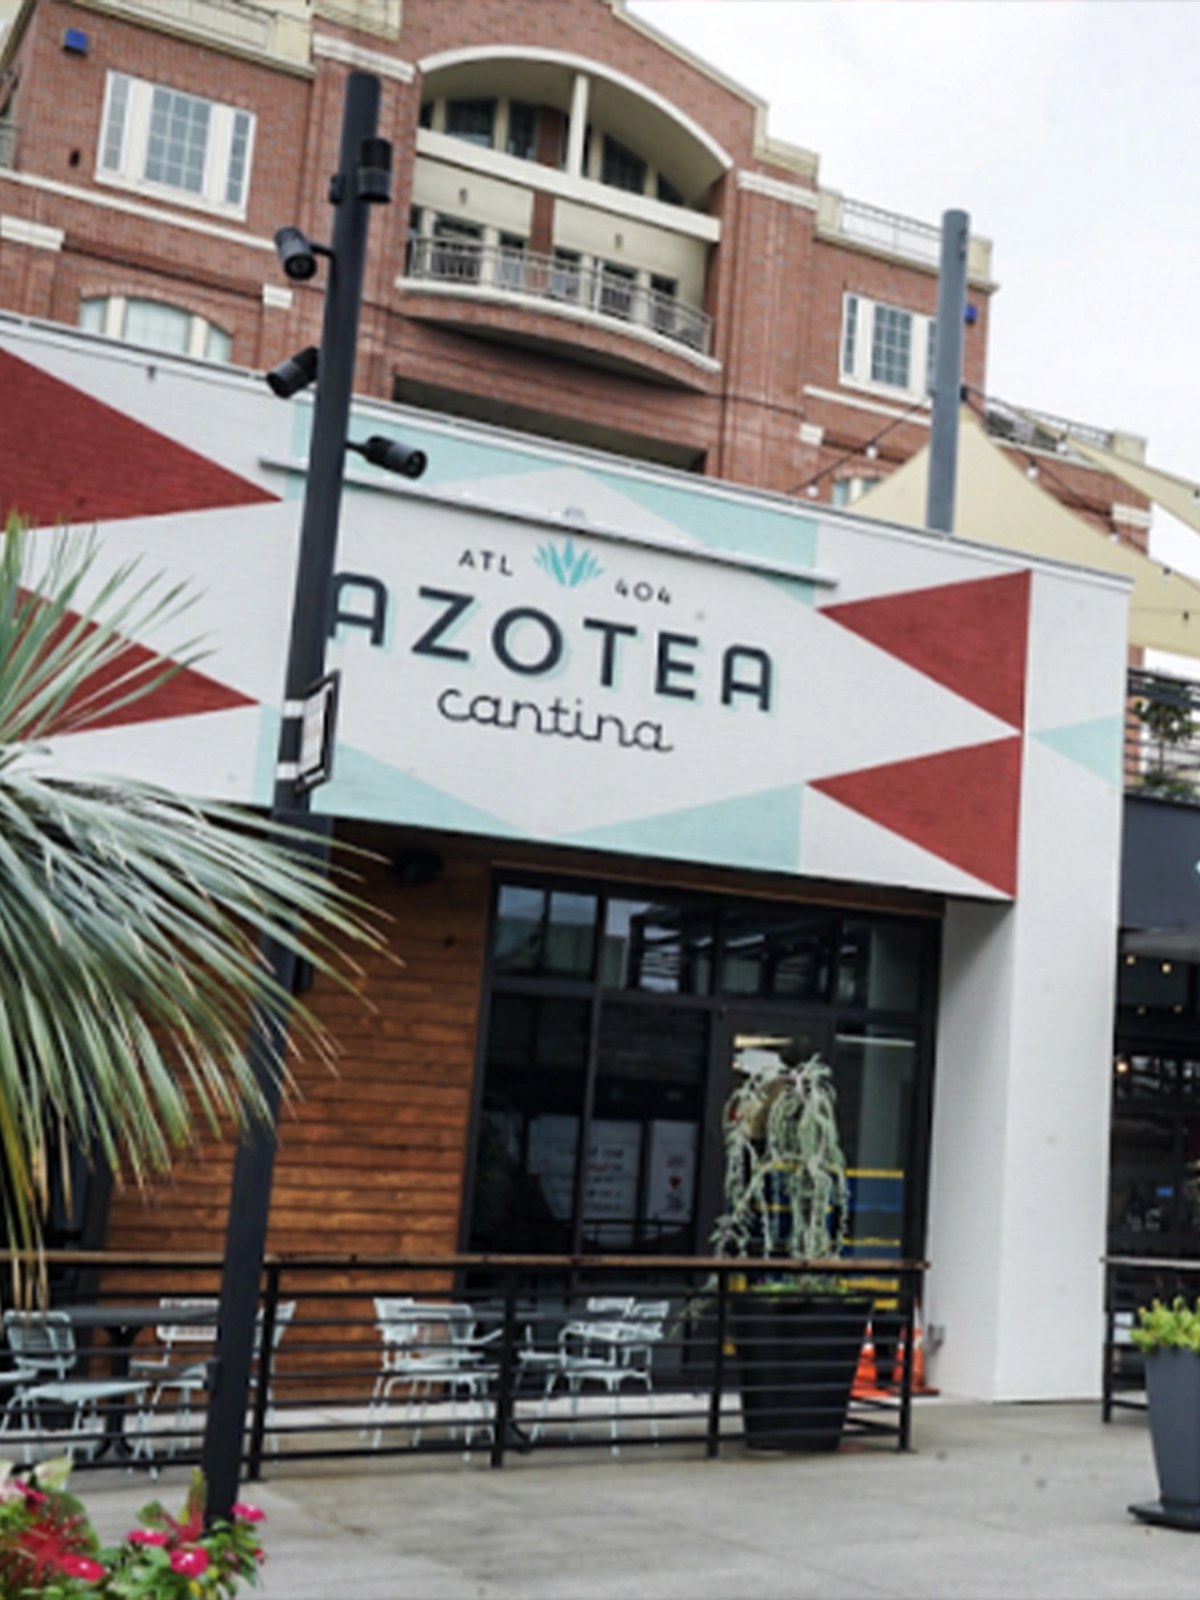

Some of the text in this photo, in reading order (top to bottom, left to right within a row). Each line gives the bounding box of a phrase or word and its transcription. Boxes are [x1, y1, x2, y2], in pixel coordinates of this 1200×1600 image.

[458, 548, 673, 605] ATL 404
[328, 571, 773, 713] AZOTEA
[436, 687, 674, 753] cantina
